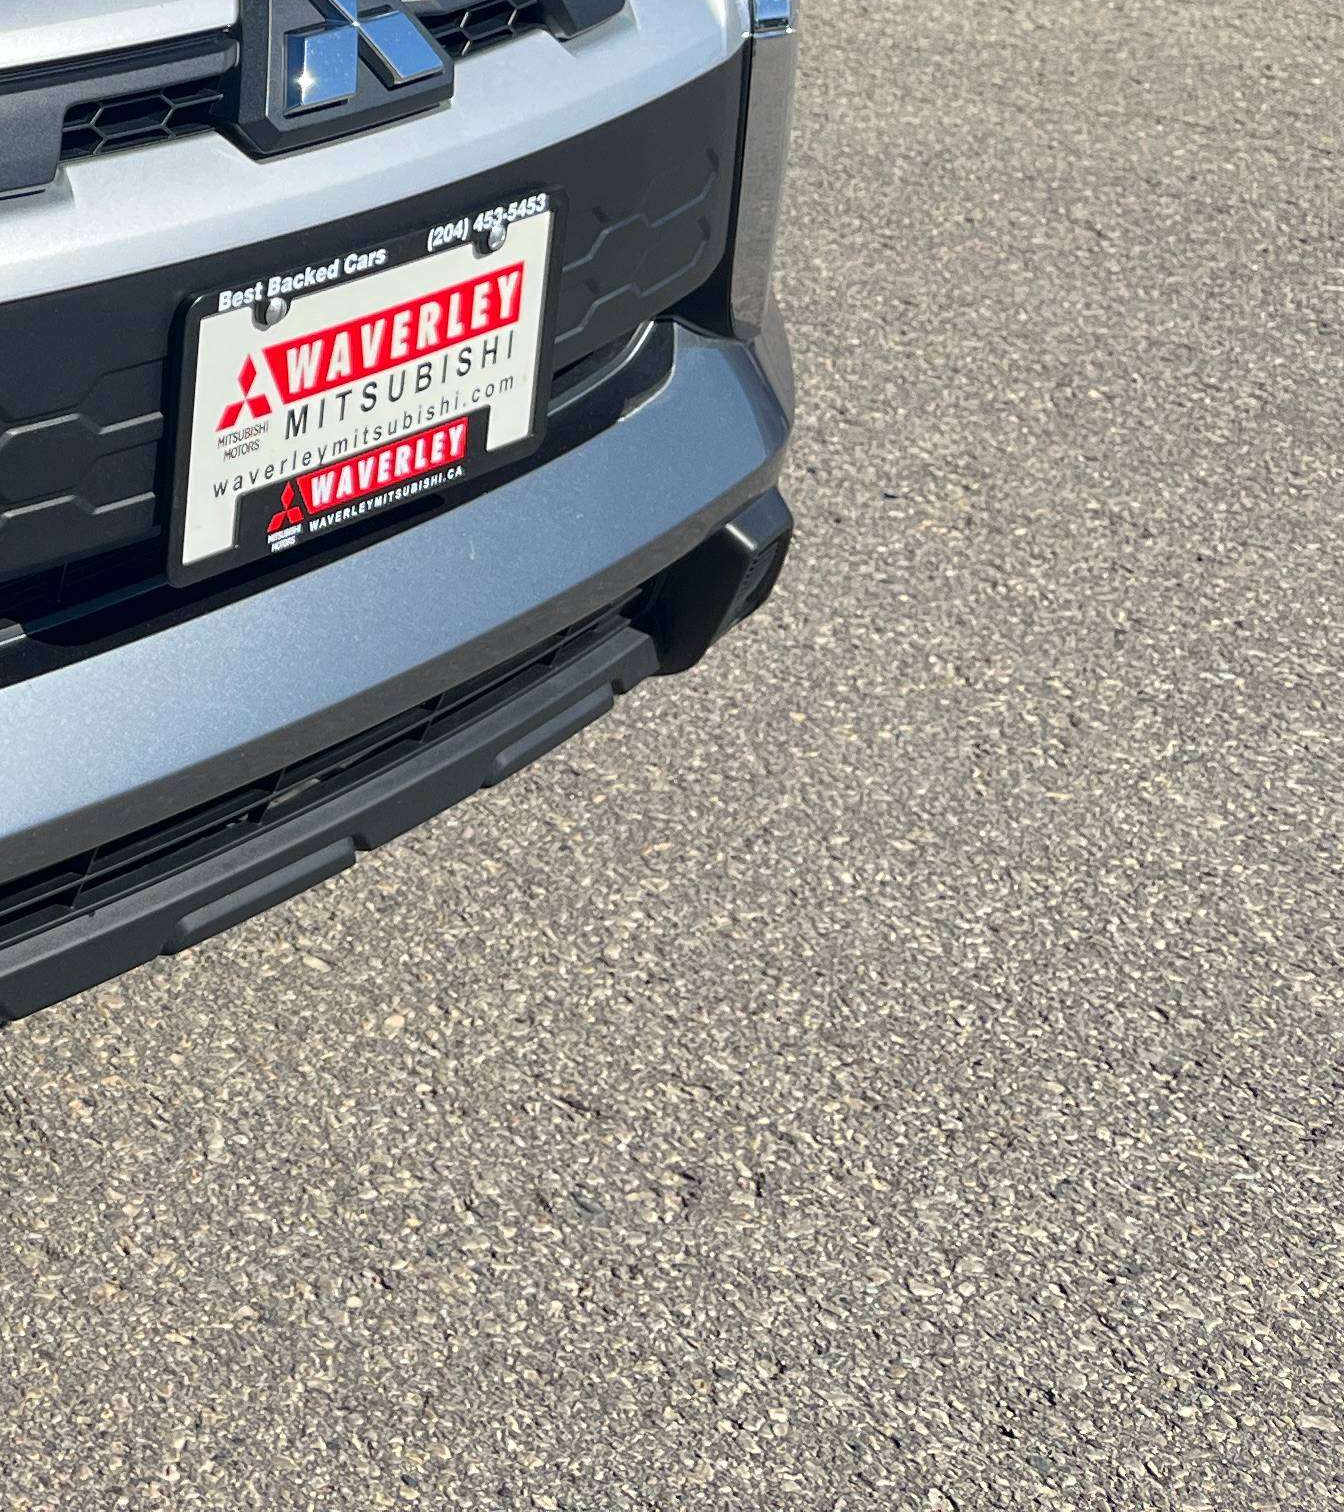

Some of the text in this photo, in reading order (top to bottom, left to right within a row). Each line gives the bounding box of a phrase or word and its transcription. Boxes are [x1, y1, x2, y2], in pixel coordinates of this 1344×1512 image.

[218, 192, 548, 313] Best Backed Cars (204) 453-5453
[285, 268, 523, 397] WAVERLEY
[216, 420, 270, 448] MITSUBISHI
[284, 329, 515, 441] MITSUBISHI
[212, 372, 515, 498] waverleymitsubishi.com
[223, 438, 261, 463] MOTORS
[309, 423, 466, 508] WAVERLEY
[308, 464, 464, 533] WAVERLEYMITSUBISHI.CA
